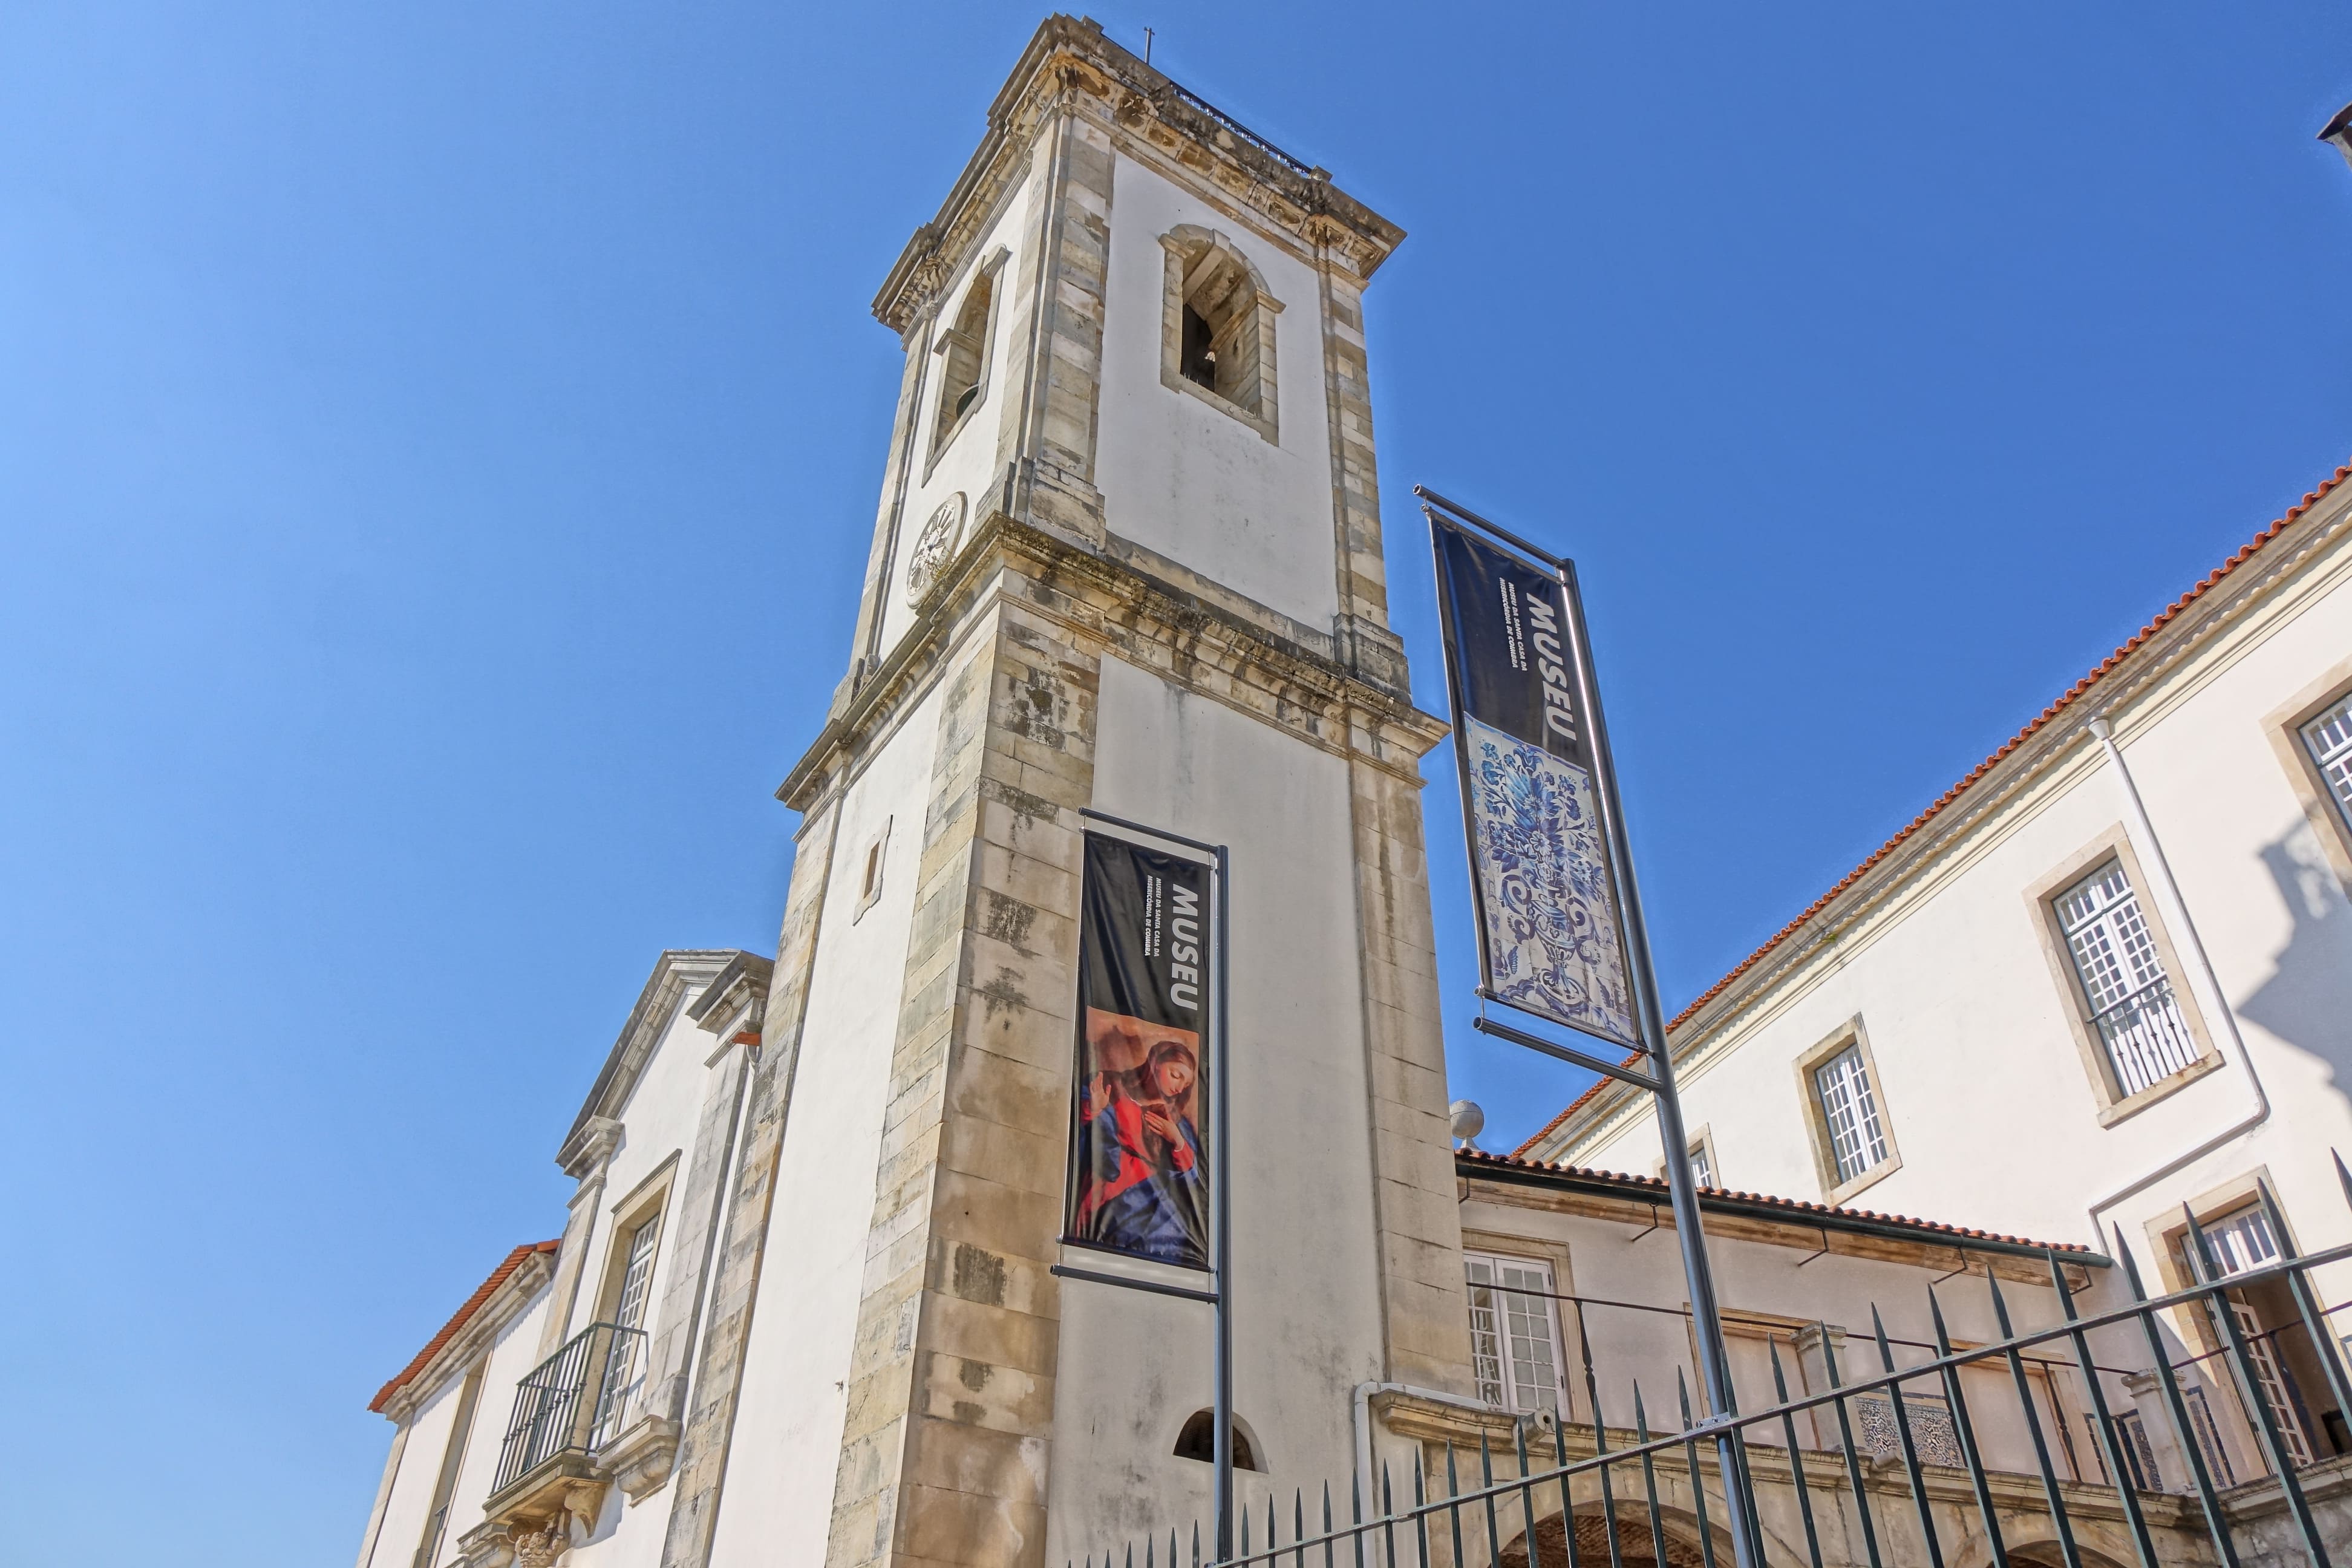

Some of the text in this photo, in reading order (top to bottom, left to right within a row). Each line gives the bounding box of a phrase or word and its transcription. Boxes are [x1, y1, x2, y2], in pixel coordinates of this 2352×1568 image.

[1508, 582, 1517, 606] MUSEU
[1512, 607, 1518, 616] DA
[1499, 577, 1518, 668] MISERICÓRDIA DE COIMBRA
[1521, 661, 1527, 671] DA
[1526, 592, 1576, 741] MUSEU
[1155, 899, 1161, 907] DA
[1146, 918, 1151, 927] DE
[1154, 948, 1160, 956] DA
[1170, 883, 1198, 1011] MUSEU
